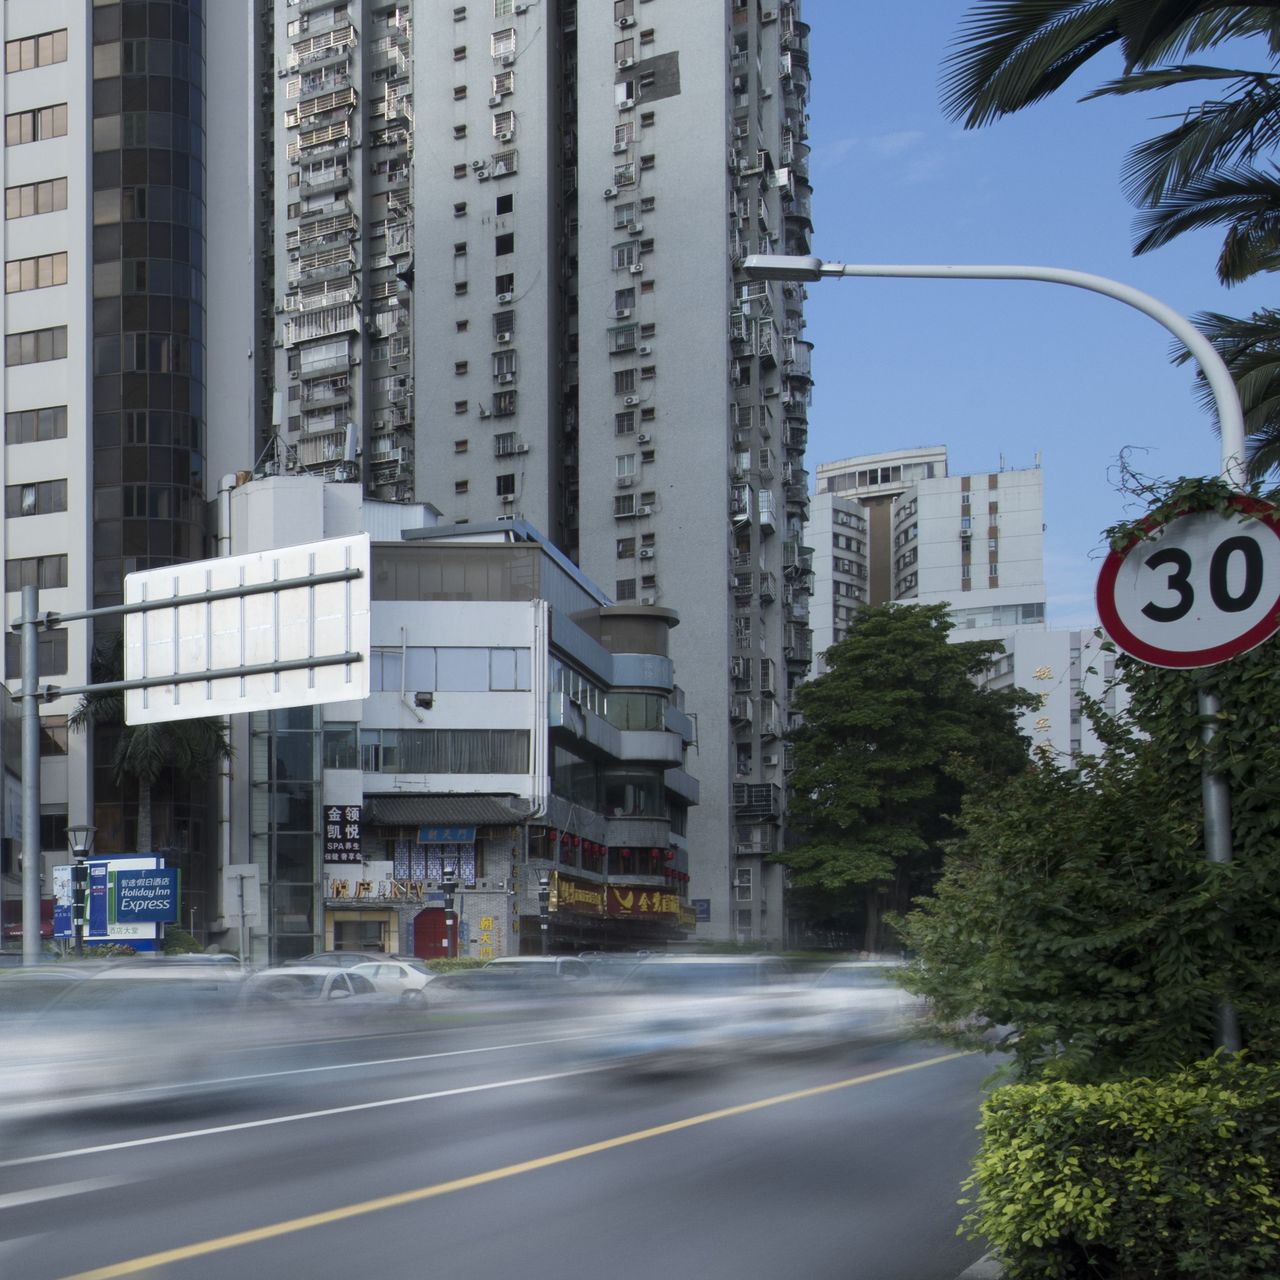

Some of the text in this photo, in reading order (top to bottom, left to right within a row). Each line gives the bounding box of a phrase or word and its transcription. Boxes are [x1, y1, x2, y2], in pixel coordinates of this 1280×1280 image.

[1141, 535, 1264, 622] 30
[327, 806, 360, 822] 金领
[327, 824, 360, 839] 凯悦
[120, 877, 171, 887] 智选假日酒店
[120, 886, 171, 898] Holiday Inn
[120, 898, 171, 913] Express
